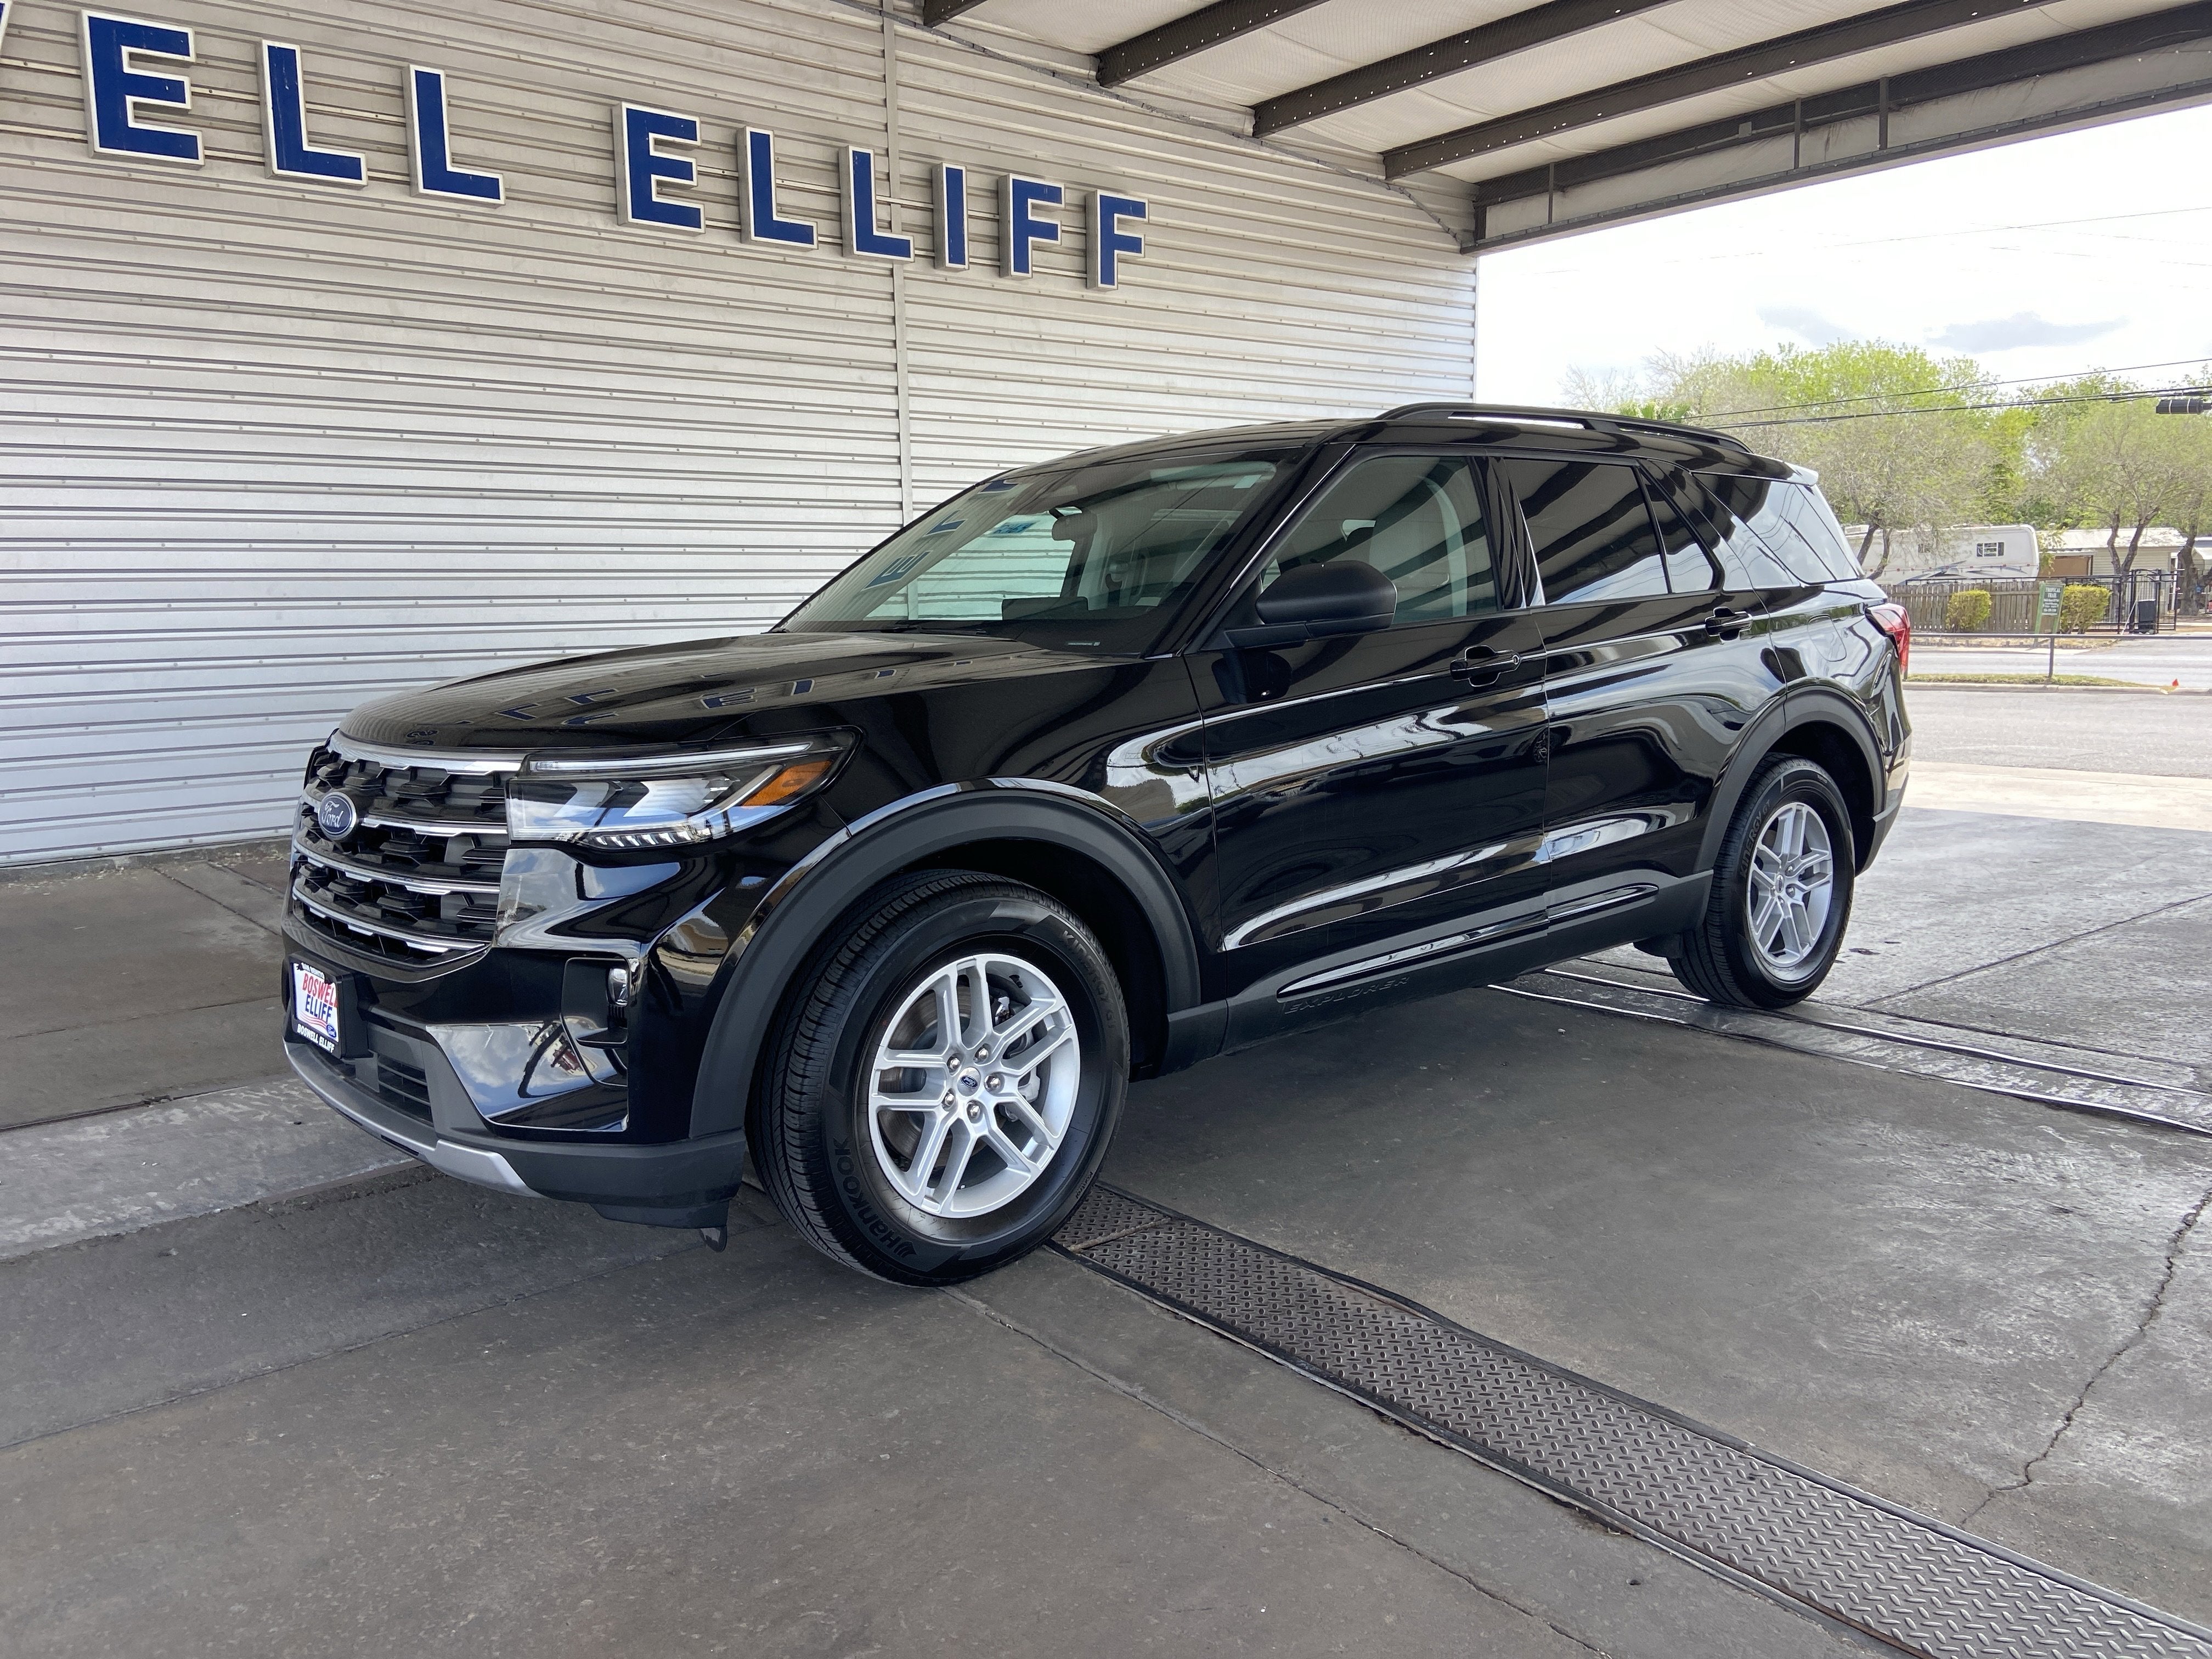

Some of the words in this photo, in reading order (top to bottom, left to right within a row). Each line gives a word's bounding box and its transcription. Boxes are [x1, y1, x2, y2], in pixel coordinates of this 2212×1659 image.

[0, 0, 506, 208] ELL
[612, 100, 1149, 292] ELLIFF
[322, 800, 344, 828] Ford
[304, 994, 332, 1024] ELLIFF
[1283, 977, 1410, 1014] EXPLORER
[297, 1023, 319, 1044] BOSWELL
[318, 1036, 335, 1053] ELLIFF
